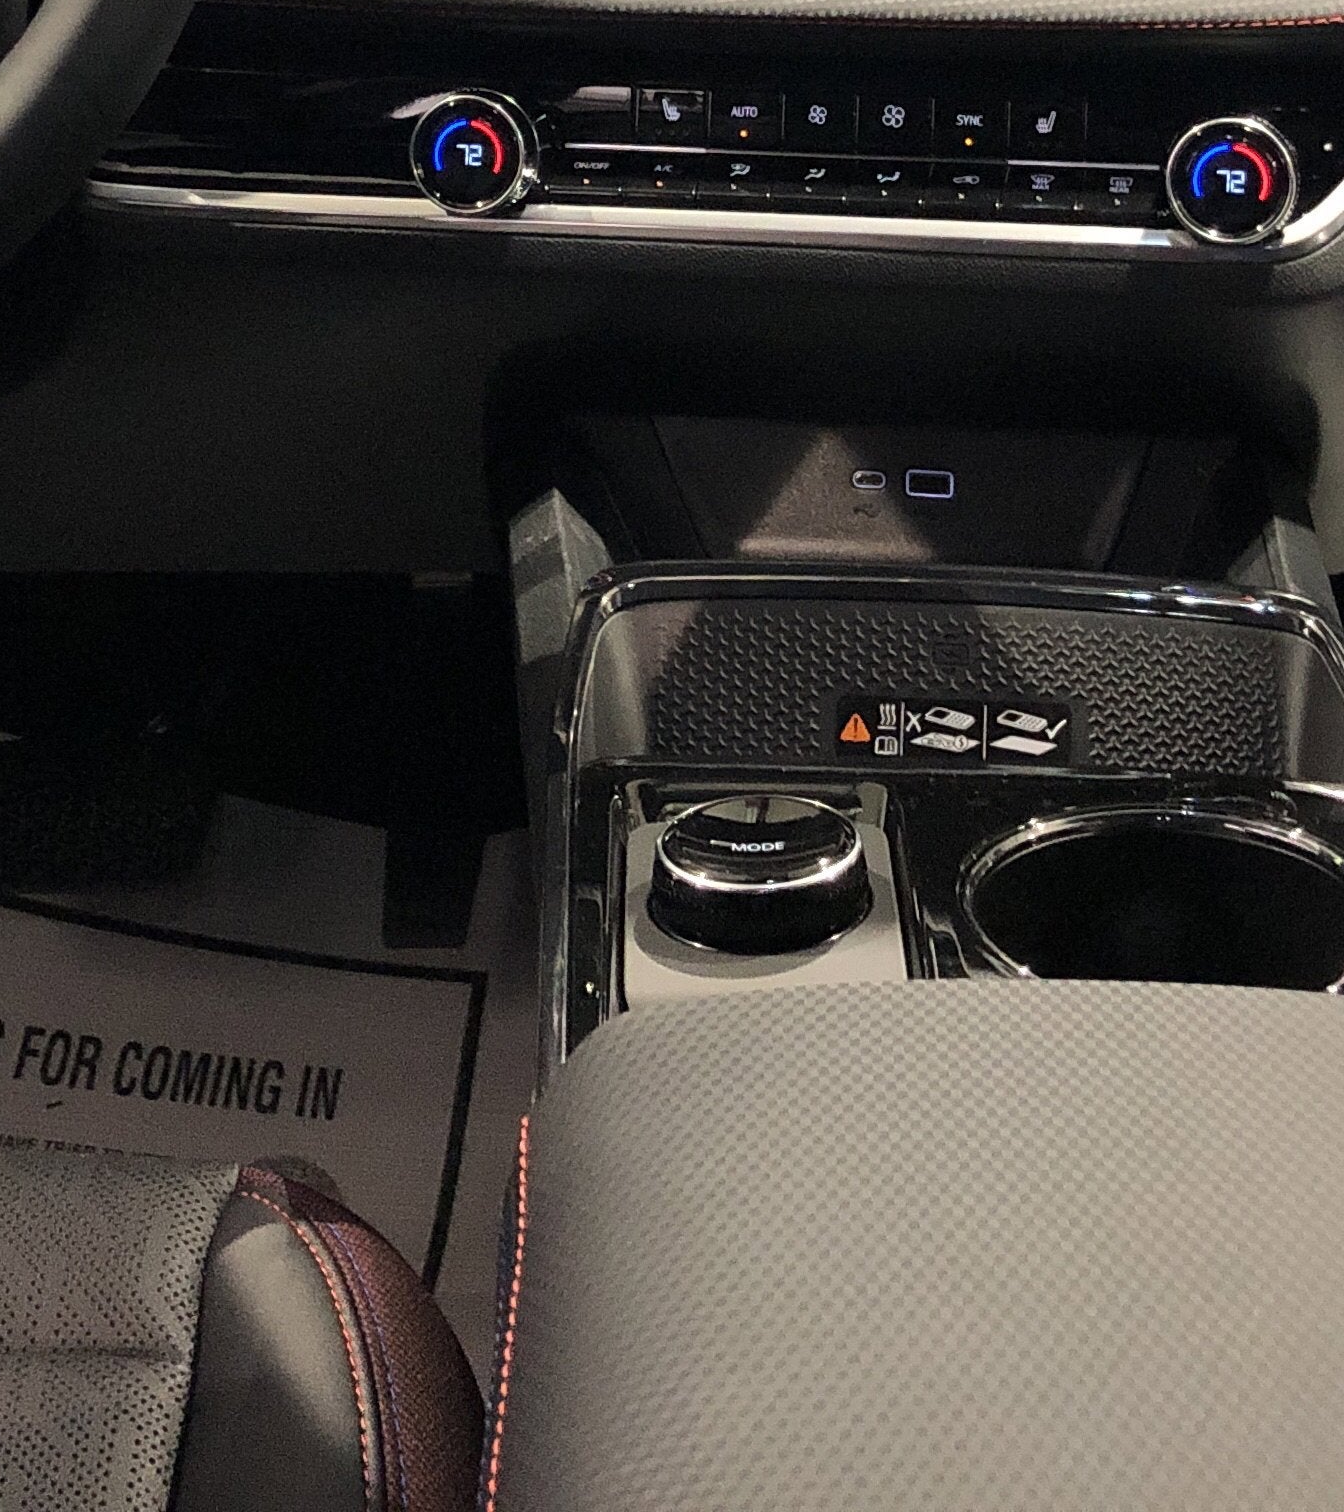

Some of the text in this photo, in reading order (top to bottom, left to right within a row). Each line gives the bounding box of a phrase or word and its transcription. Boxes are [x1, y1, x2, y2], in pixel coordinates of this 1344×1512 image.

[730, 105, 758, 118] AUTO
[956, 114, 984, 128] SYNC
[456, 144, 483, 167] 72
[654, 164, 673, 174] A/C
[1216, 169, 1247, 194] 72
[731, 841, 785, 852] MODE
[12, 1025, 104, 1090] FOR
[113, 1040, 286, 1115] COMING
[294, 1065, 346, 1121] IN
